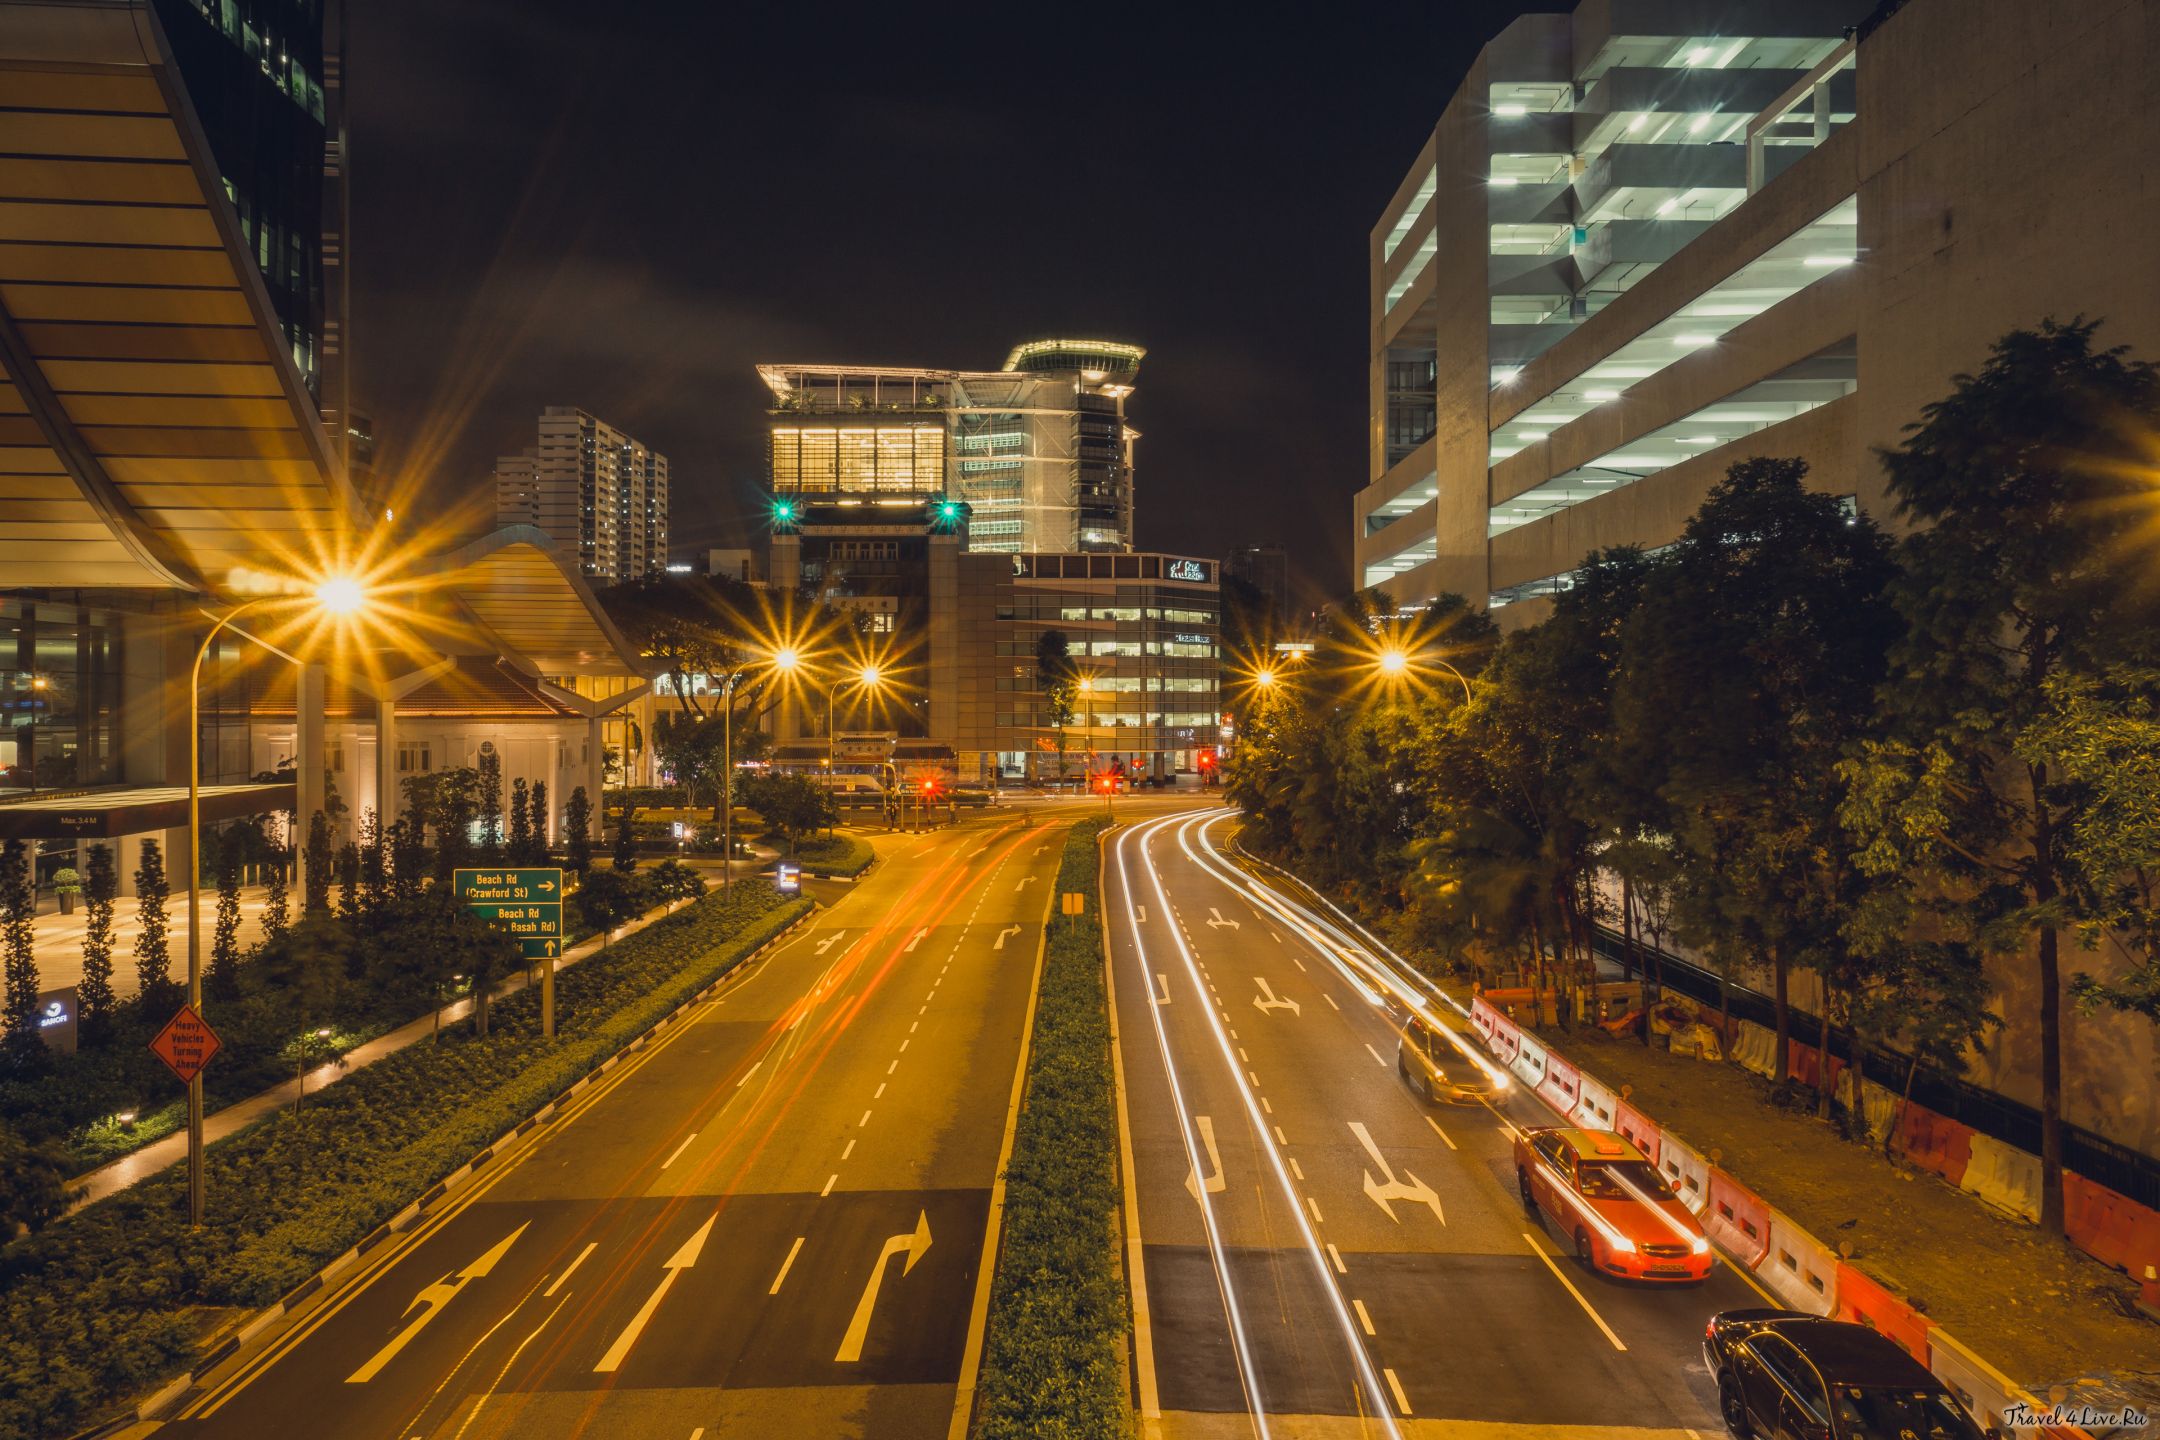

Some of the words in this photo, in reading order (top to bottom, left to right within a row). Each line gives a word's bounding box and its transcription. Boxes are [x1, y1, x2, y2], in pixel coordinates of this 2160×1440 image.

[476, 874, 502, 885] Beach
[506, 874, 518, 885] Rd
[466, 887, 510, 898] (Crawford
[514, 887, 529, 899] St)
[498, 908, 524, 919] Beach
[528, 908, 540, 919] Rd
[511, 922, 537, 932] Basah
[541, 921, 556, 933] Rd)
[175, 1020, 200, 1031] Heavy
[171, 1033, 204, 1043] Vehicles
[172, 1046, 202, 1058] Turning
[175, 1059, 200, 1069] Ahead
